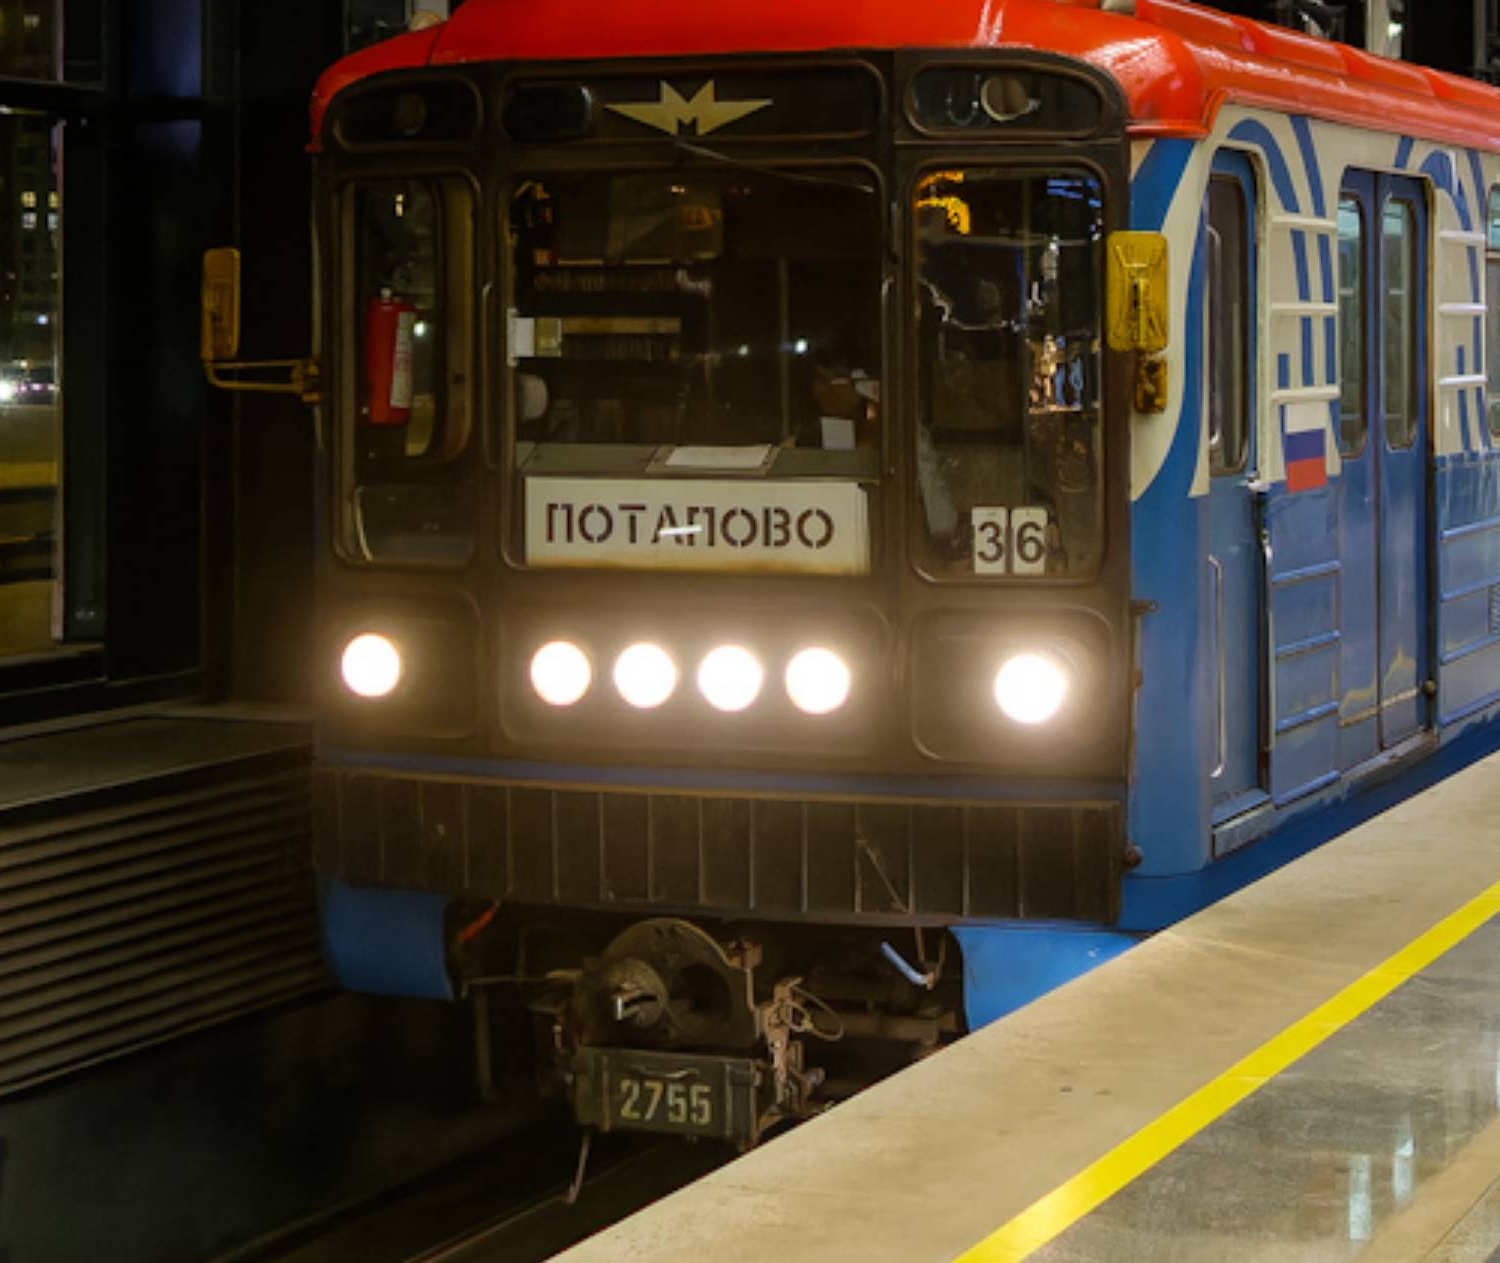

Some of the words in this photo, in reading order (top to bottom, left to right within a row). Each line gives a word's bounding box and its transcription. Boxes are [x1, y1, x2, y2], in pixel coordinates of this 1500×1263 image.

[546, 503, 834, 549] ПОТАПОВО
[978, 521, 1045, 564] 36
[619, 1079, 712, 1125] 2755
